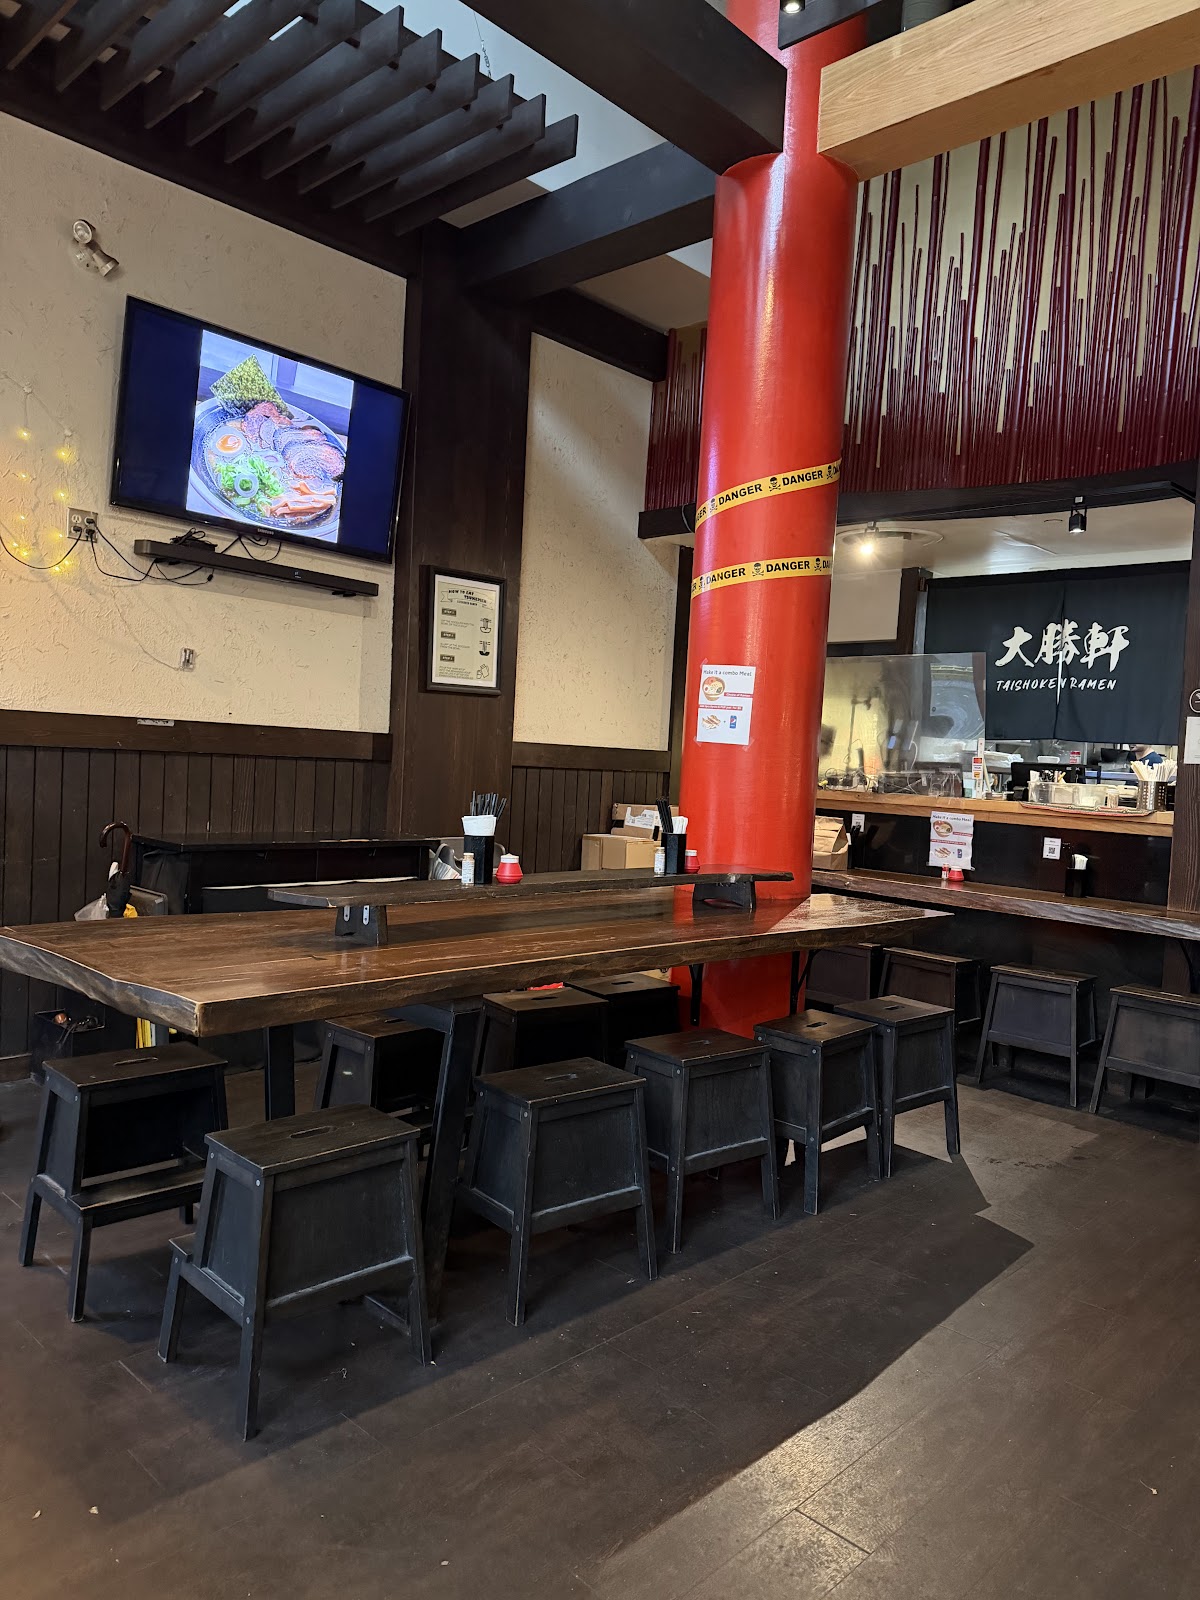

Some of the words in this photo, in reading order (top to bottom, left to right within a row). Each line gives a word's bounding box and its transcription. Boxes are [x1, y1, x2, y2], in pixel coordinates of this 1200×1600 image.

[718, 483, 763, 505] DANGER
[782, 470, 823, 486] DANGER
[706, 567, 746, 584] DANGER
[766, 560, 810, 572] DANGER
[995, 618, 1130, 672] 大勝軒
[996, 677, 1067, 692] TAISHOKEN
[1069, 677, 1117, 691] RAMEN
